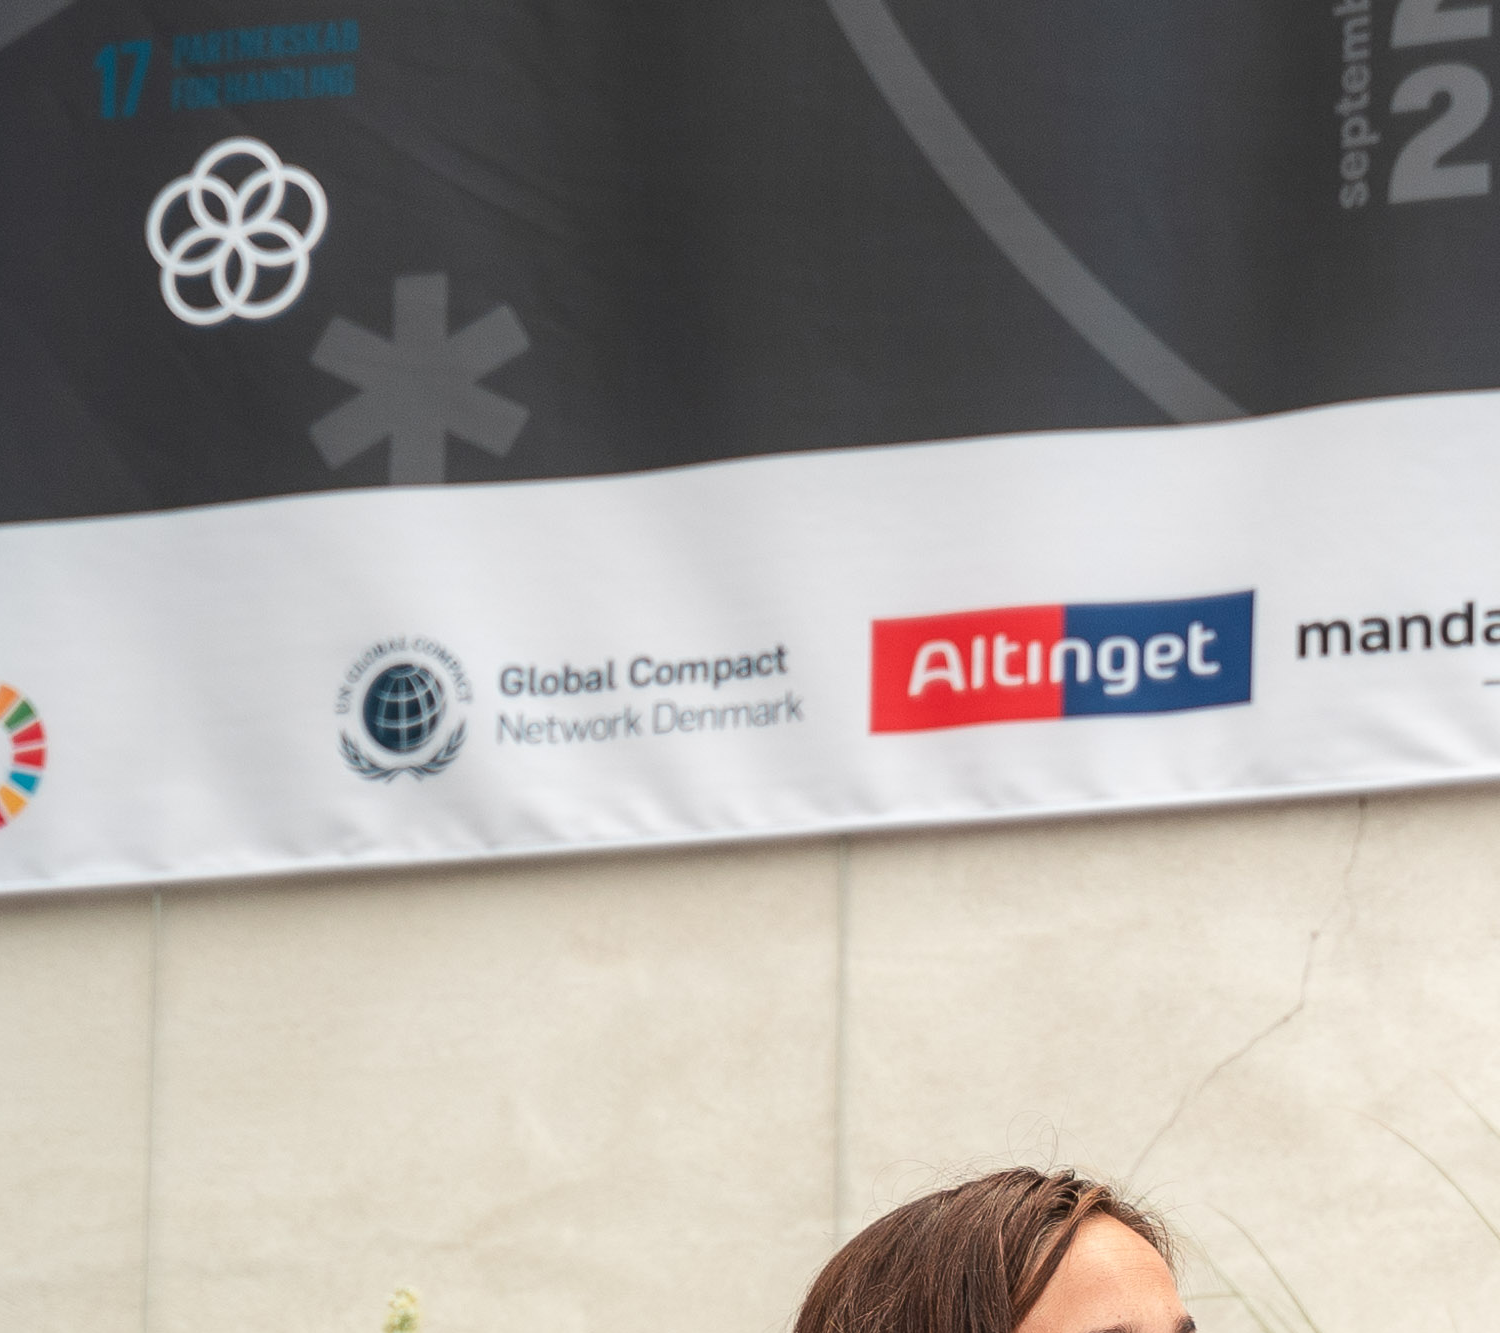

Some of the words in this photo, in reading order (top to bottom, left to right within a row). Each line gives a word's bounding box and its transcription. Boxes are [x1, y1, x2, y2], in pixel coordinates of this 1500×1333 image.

[95, 39, 152, 119] 17
[500, 659, 617, 696] Global
[628, 645, 788, 689] Compact
[907, 619, 1220, 697] Altinget
[496, 705, 642, 744] Network
[652, 692, 804, 735] Denmark
